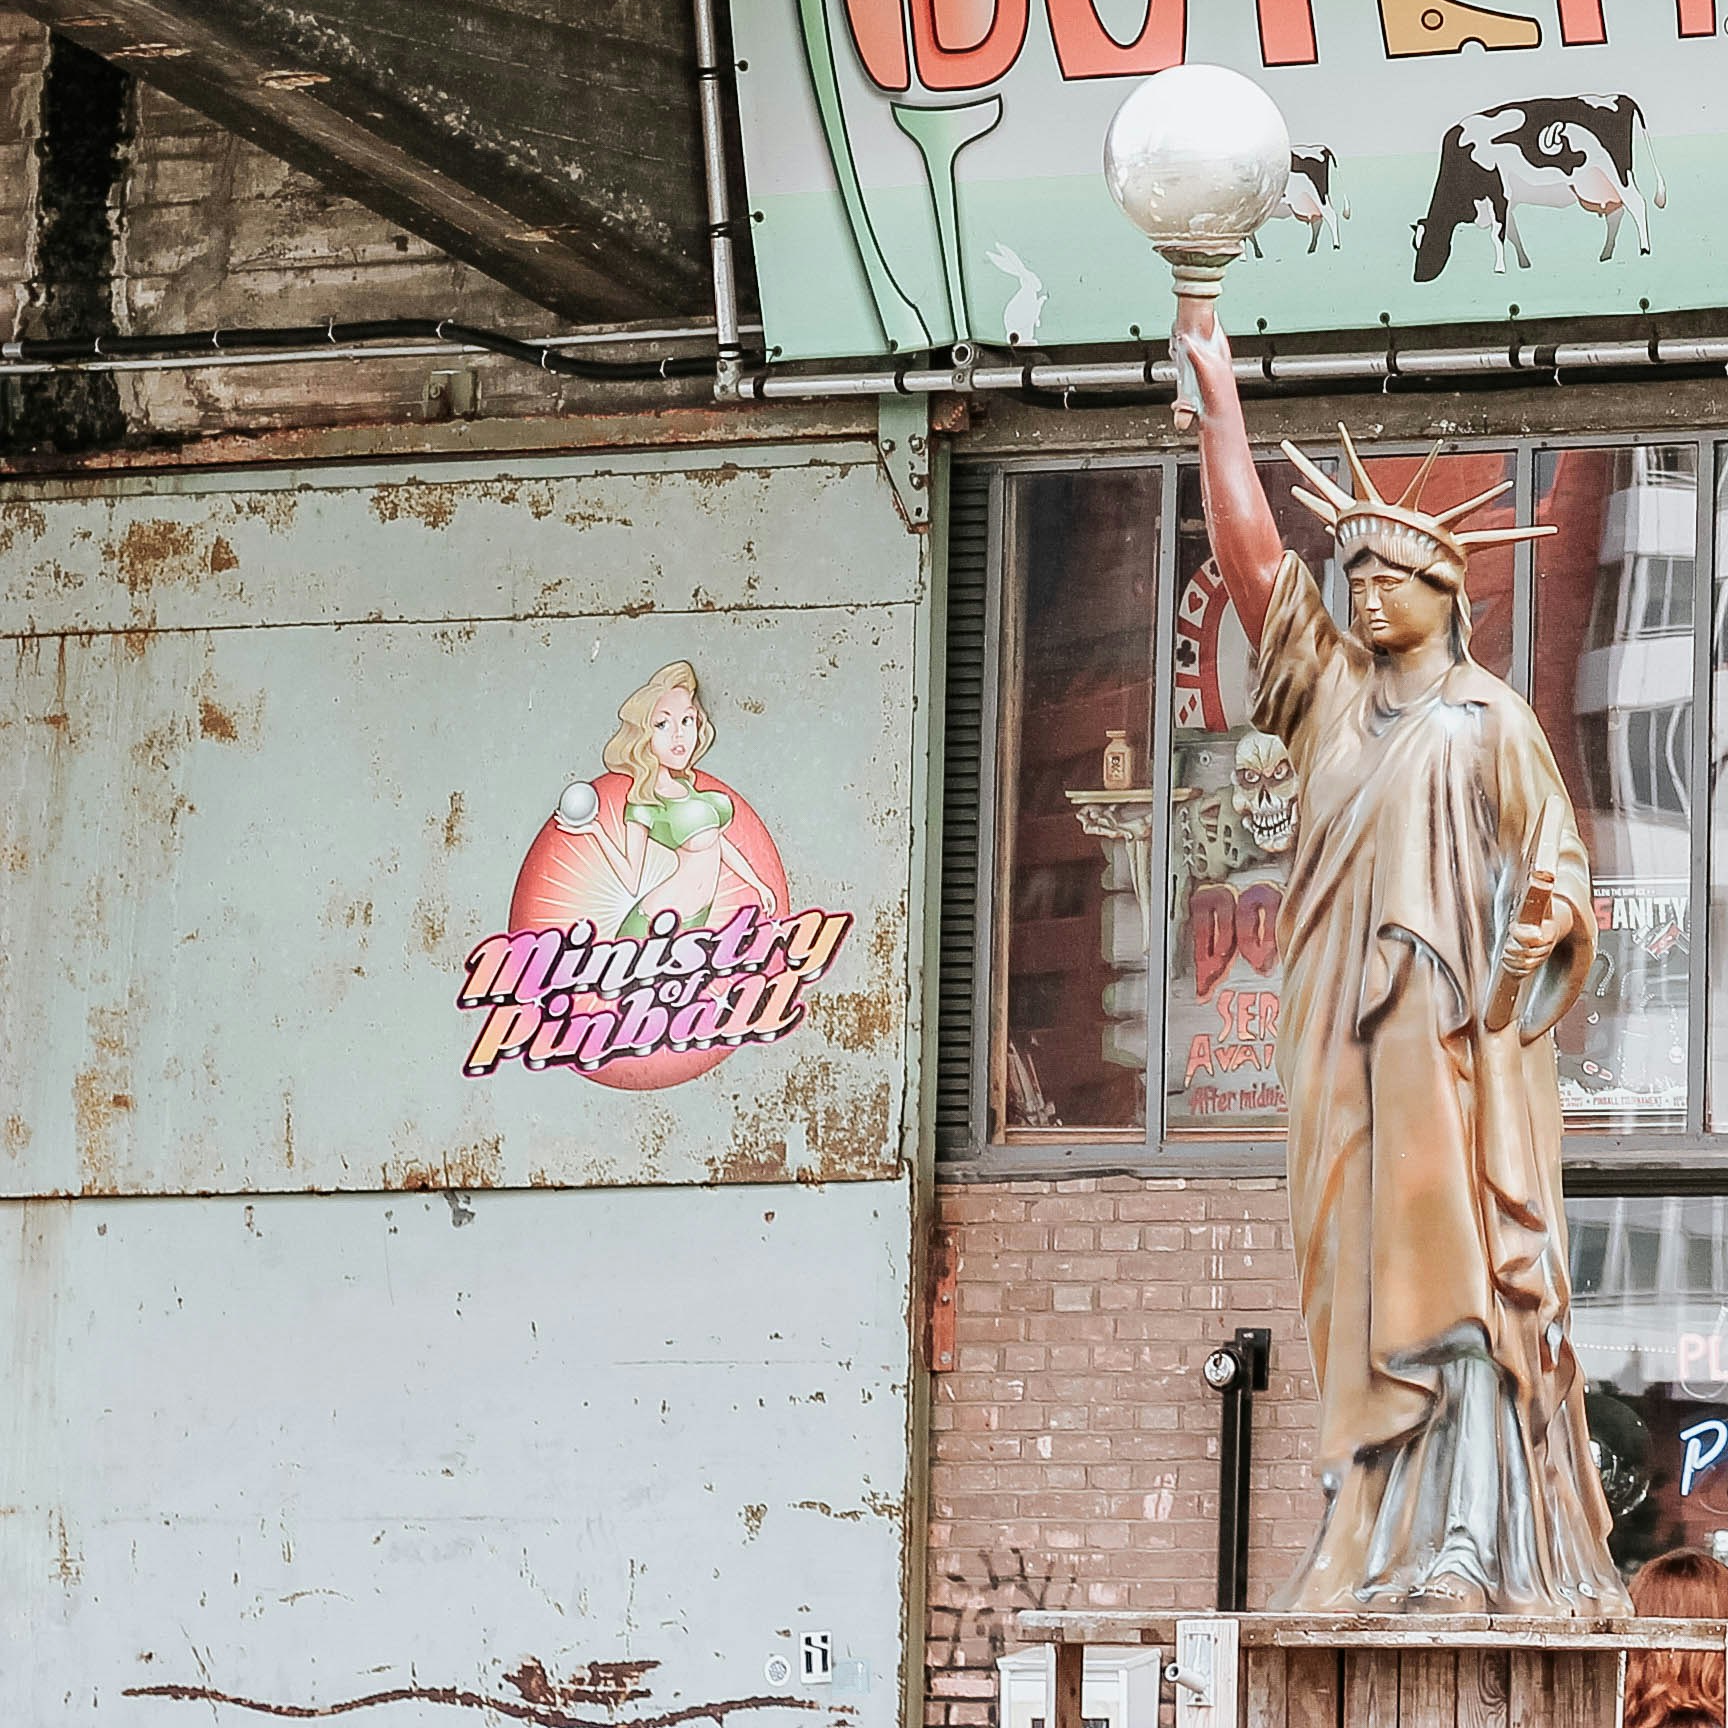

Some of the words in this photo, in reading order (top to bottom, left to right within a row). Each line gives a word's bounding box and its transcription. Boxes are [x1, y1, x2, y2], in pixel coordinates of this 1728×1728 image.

[1593, 896, 1689, 931] SANITY
[1189, 879, 1285, 1006] DO
[657, 969, 712, 1008] of
[1216, 990, 1281, 1043] SER
[1183, 1033, 1276, 1089] AVAI
[1239, 1082, 1288, 1113] midni
